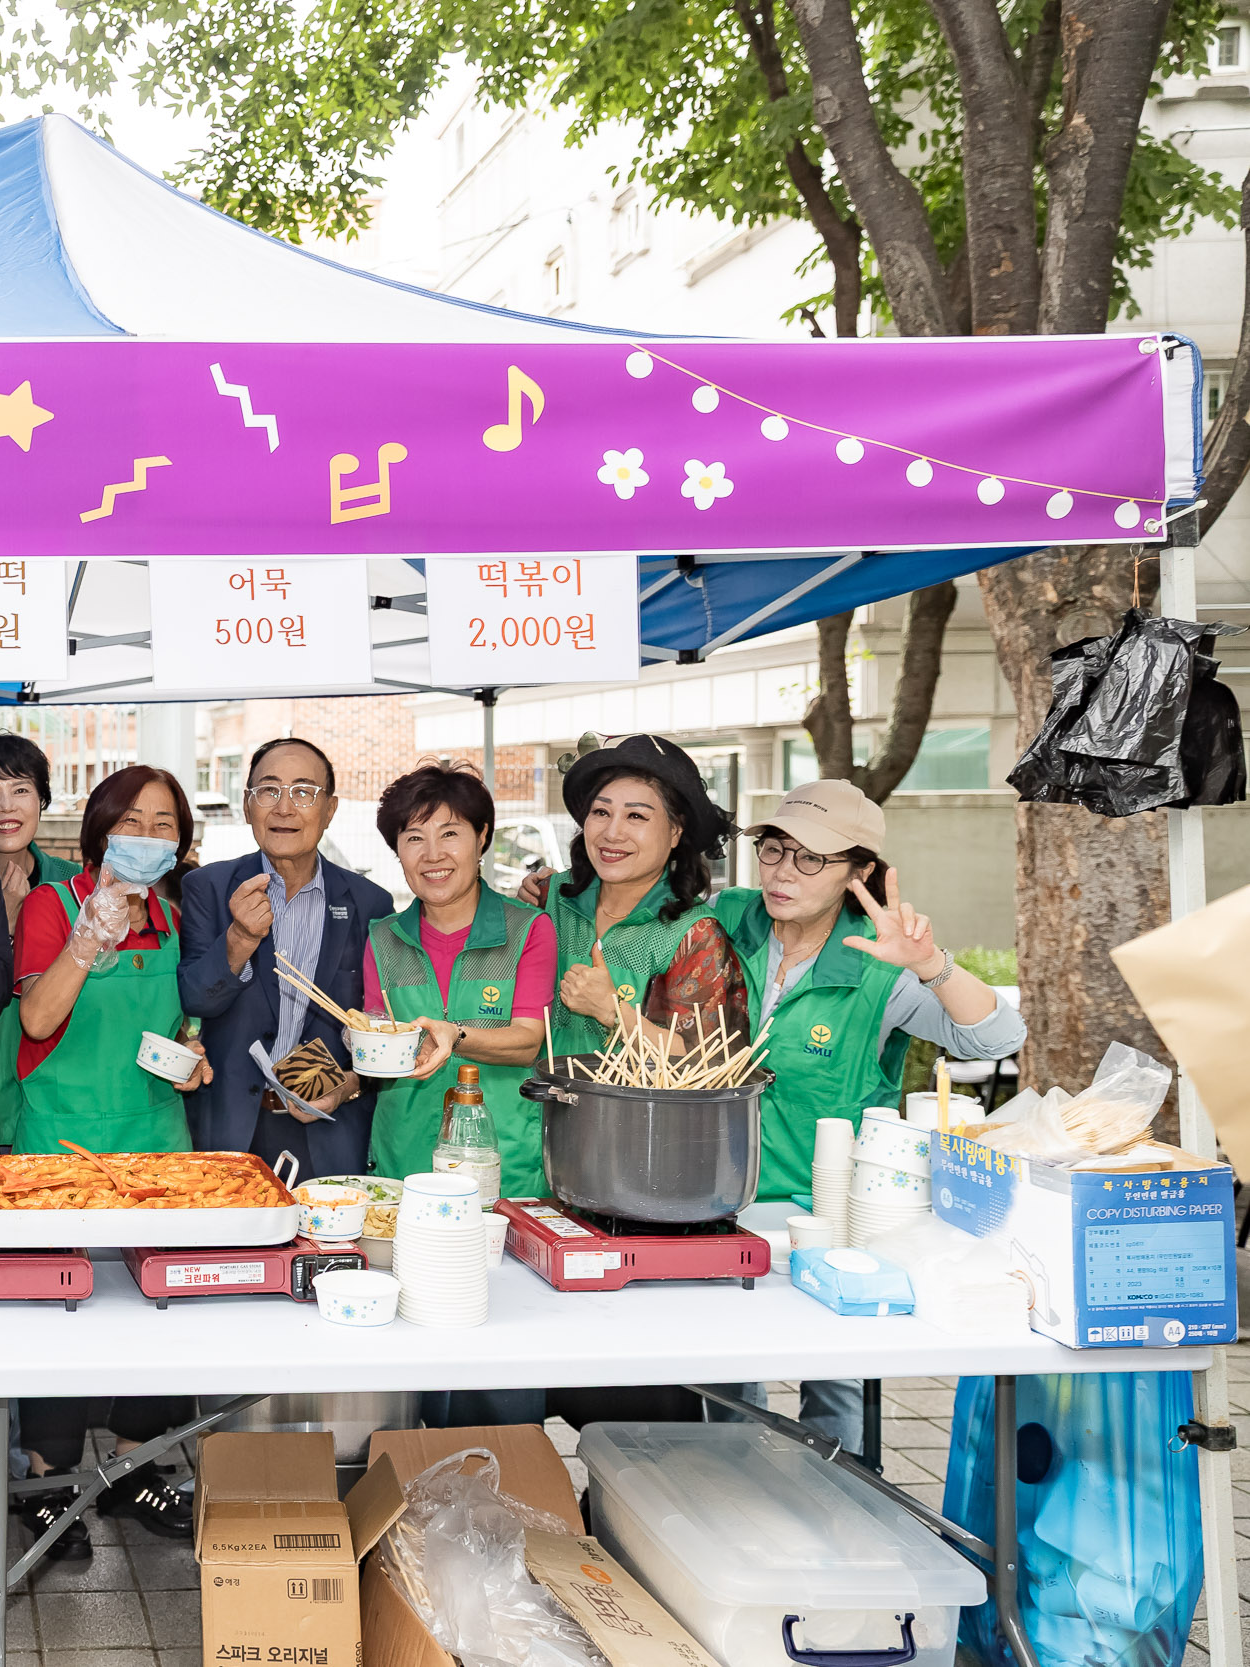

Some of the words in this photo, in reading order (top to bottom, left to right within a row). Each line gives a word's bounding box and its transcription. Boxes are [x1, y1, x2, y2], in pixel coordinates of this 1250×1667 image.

[229, 568, 292, 600] 어묵
[478, 559, 581, 598] 떡볶이
[215, 615, 306, 647] 500원
[469, 613, 596, 650] 2,000원
[478, 1005, 503, 1015] SMU
[803, 1044, 833, 1057] SMU
[1087, 1208, 1122, 1220] COPY
[1123, 1205, 1186, 1219] DISTURBING
[1189, 1204, 1222, 1215] PAPER
[184, 1273, 220, 1284] 크린파워
[1168, 1326, 1181, 1337] A4
[216, 1644, 262, 1663] 스파크
[267, 1646, 328, 1665] 오리지널
